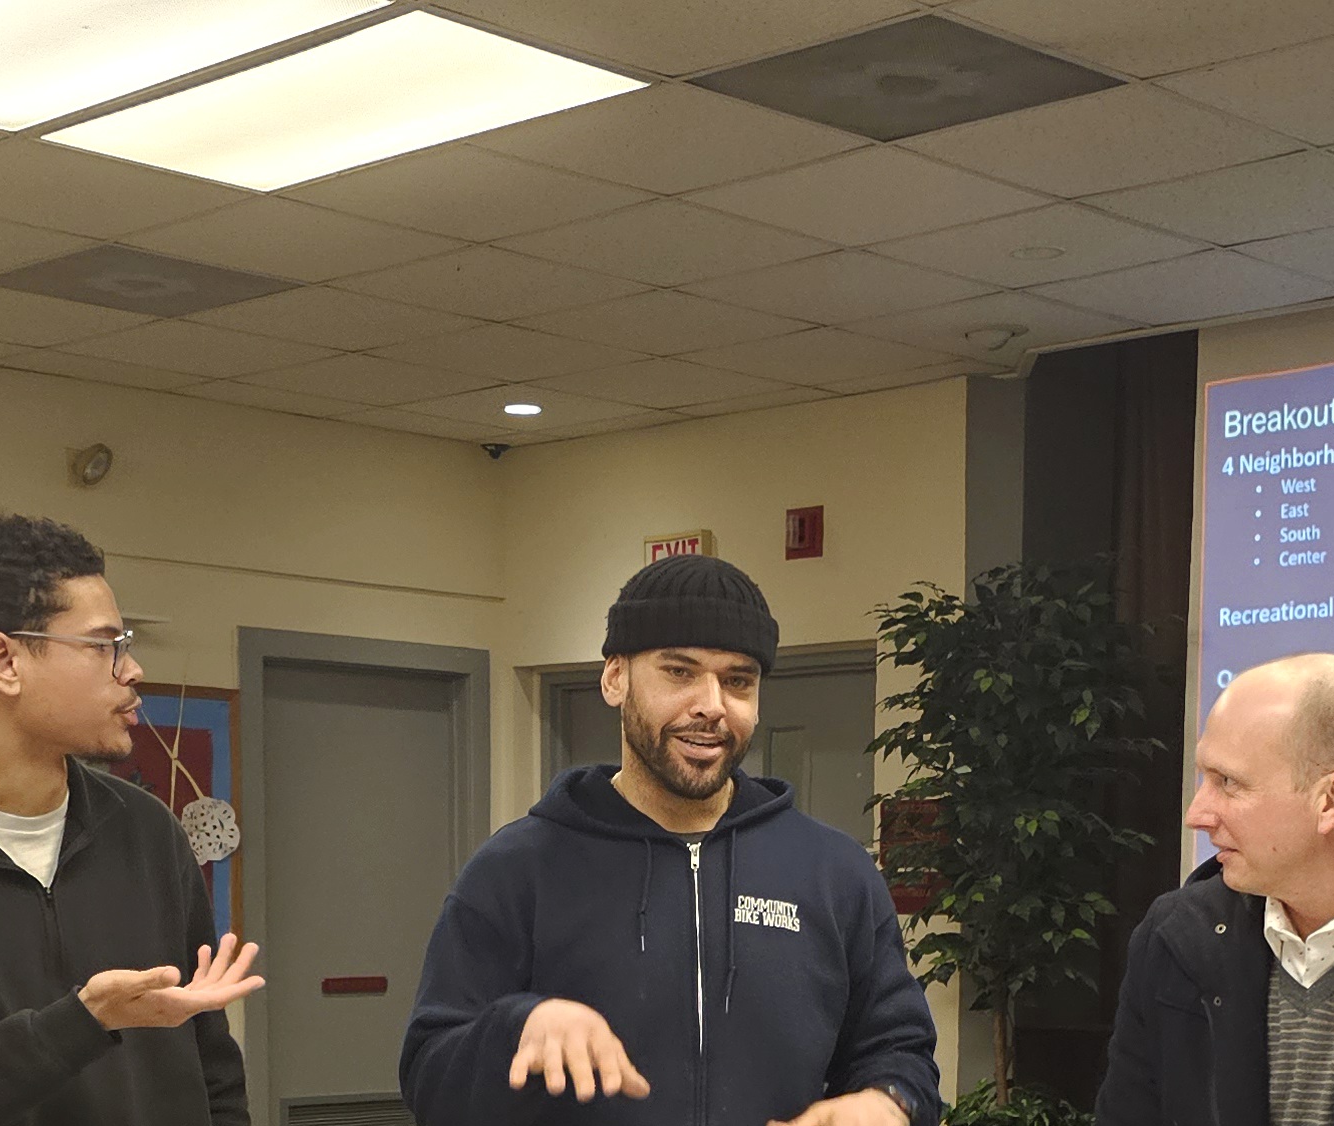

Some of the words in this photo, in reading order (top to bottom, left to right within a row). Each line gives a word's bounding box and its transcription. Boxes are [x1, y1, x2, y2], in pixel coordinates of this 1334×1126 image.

[1222, 456, 1234, 476] 4
[1280, 478, 1317, 495] West
[1280, 503, 1309, 519] East
[1279, 525, 1320, 543] South
[1278, 551, 1327, 567] Center
[1219, 597, 1334, 627] Recreational
[737, 895, 798, 917] COMMUNITY
[734, 908, 760, 925] BIKE
[762, 911, 800, 932] WORKS
